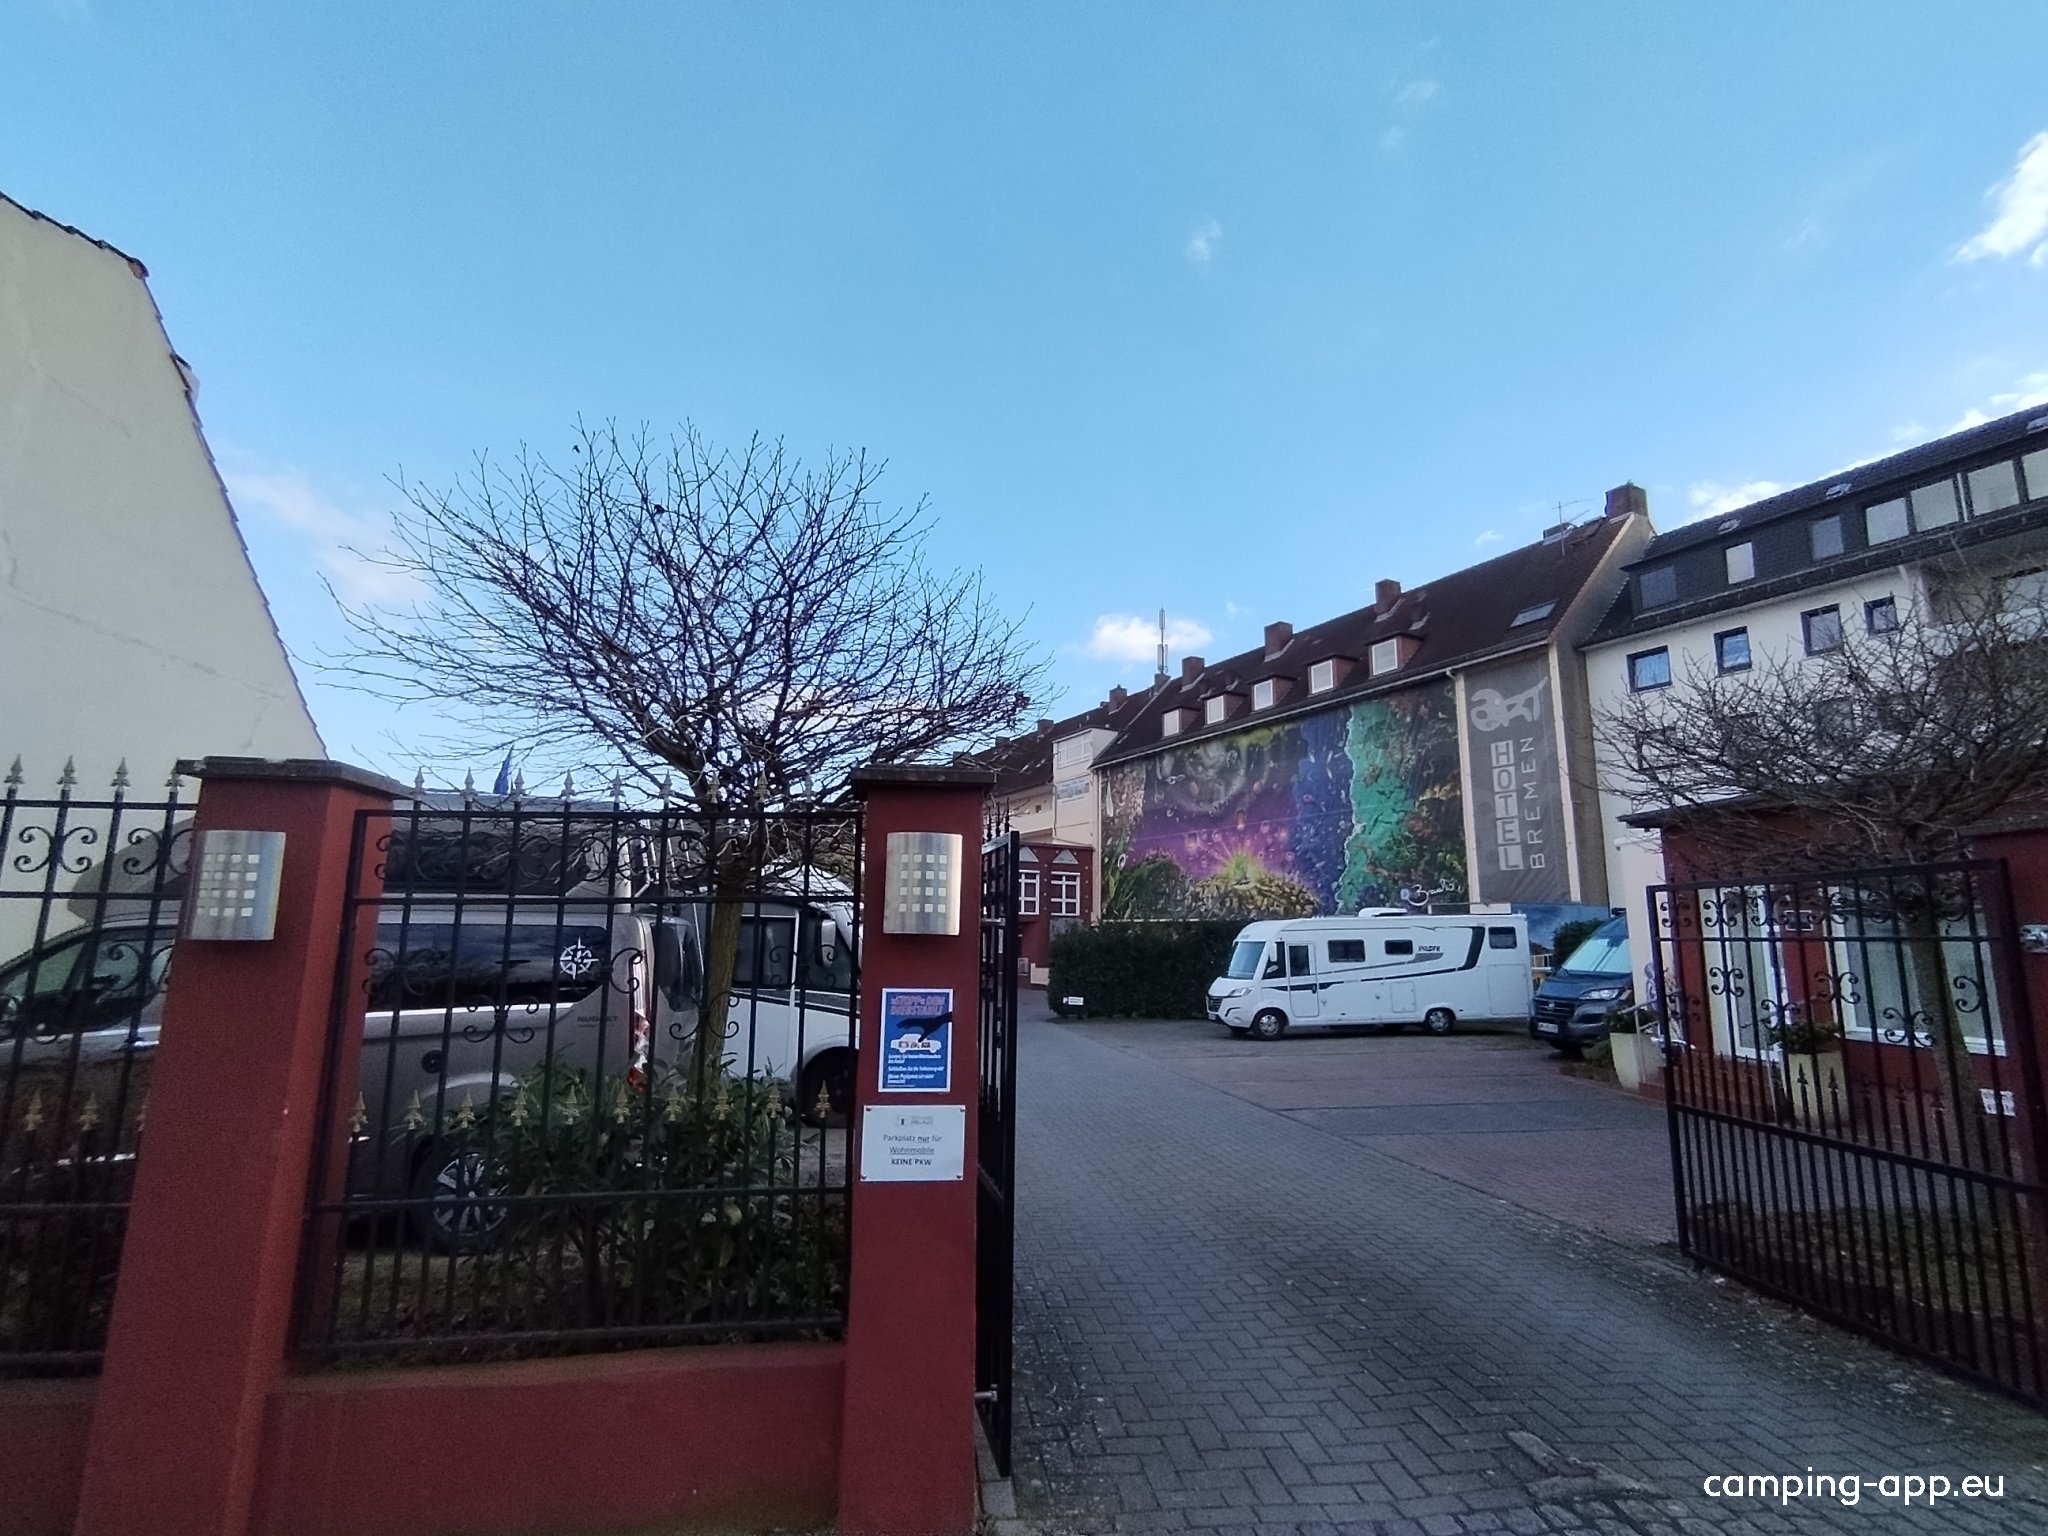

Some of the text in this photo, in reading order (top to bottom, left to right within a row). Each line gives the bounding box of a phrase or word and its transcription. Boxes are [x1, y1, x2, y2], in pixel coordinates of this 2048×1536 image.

[1492, 740, 1523, 870] HOTEL
[1520, 737, 1545, 869] BREMEN
[883, 1134, 916, 1142] Parkplatz
[931, 1134, 942, 1142] für
[889, 1146, 935, 1155] Wohnmobile
[891, 1158, 932, 1166] KEINE PKW
